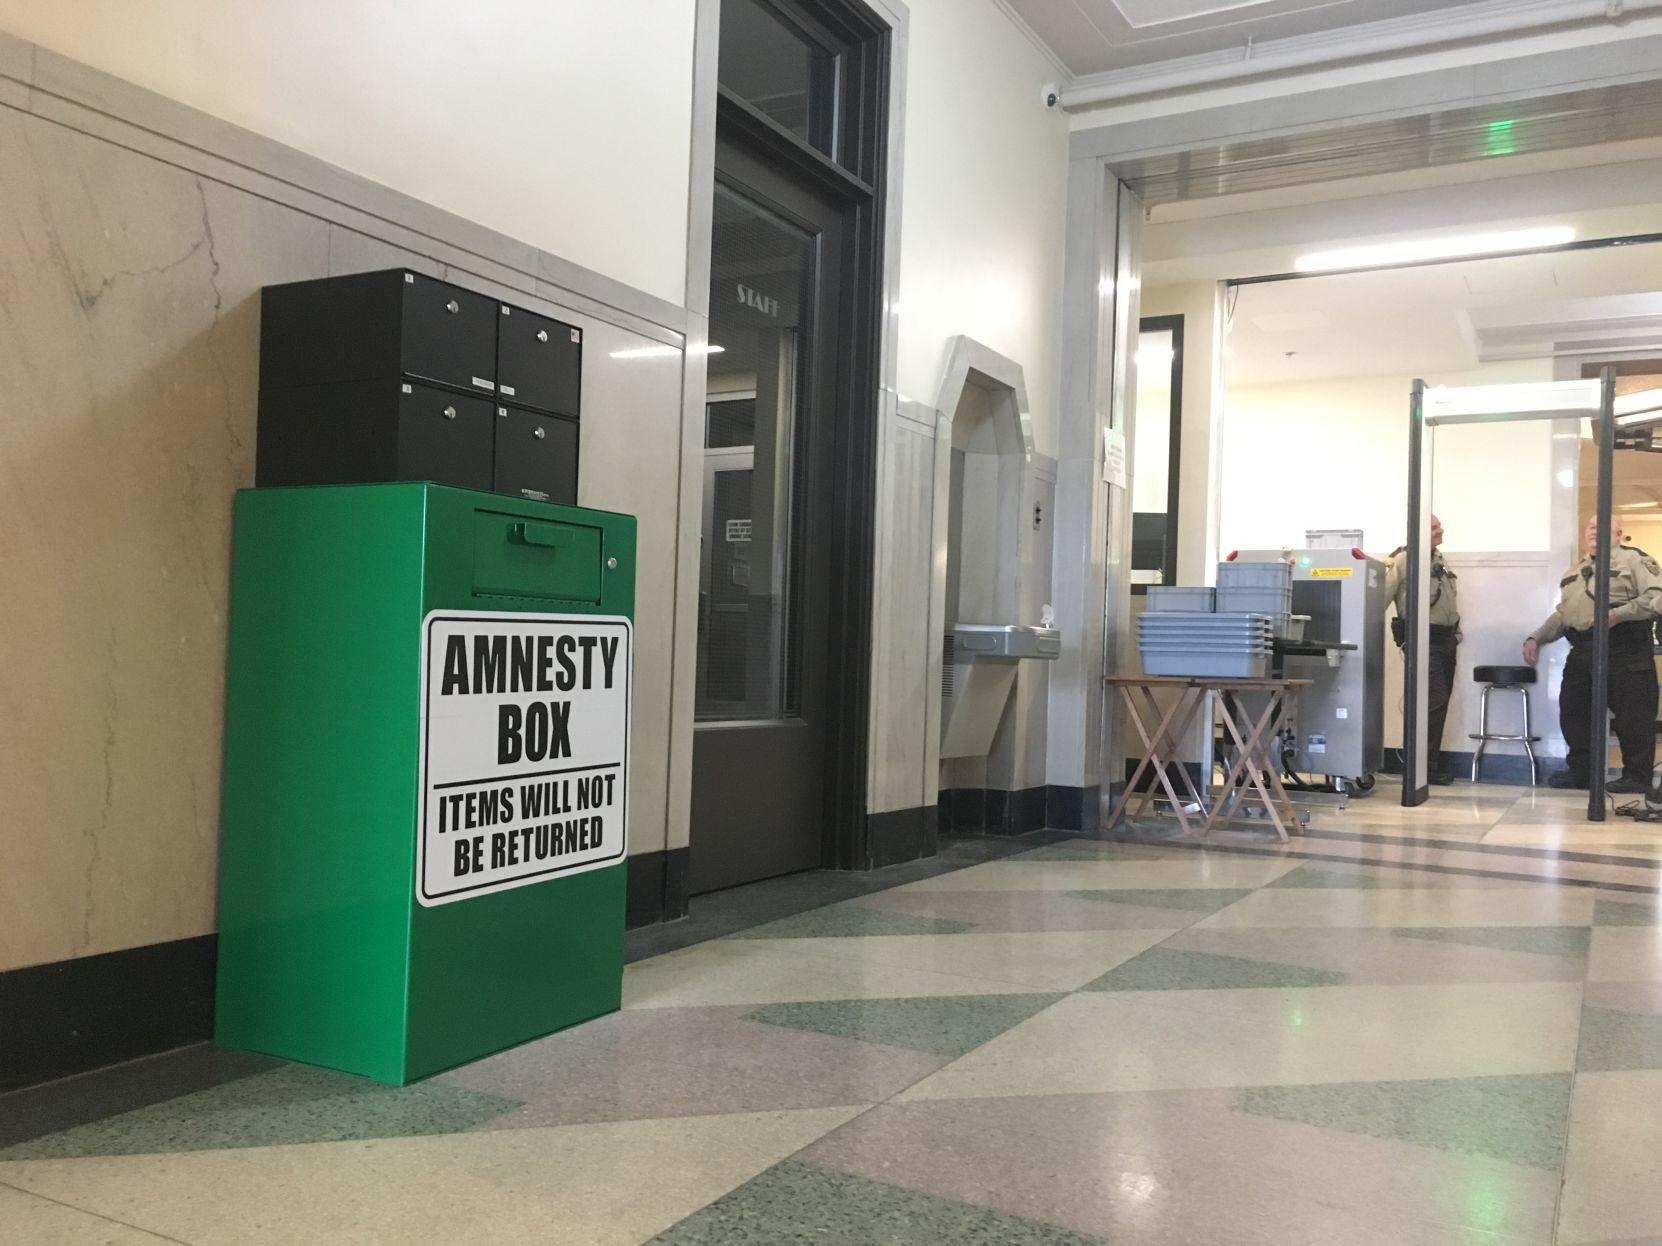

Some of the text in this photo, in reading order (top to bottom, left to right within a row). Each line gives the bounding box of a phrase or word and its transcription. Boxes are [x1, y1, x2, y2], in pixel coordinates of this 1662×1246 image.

[737, 283, 780, 317] STAFF
[441, 634, 619, 696] AMNESTY
[497, 700, 572, 765] BOX
[438, 773, 616, 834] ITEMS WILL NOT
[453, 815, 604, 878] BE RETURNED
